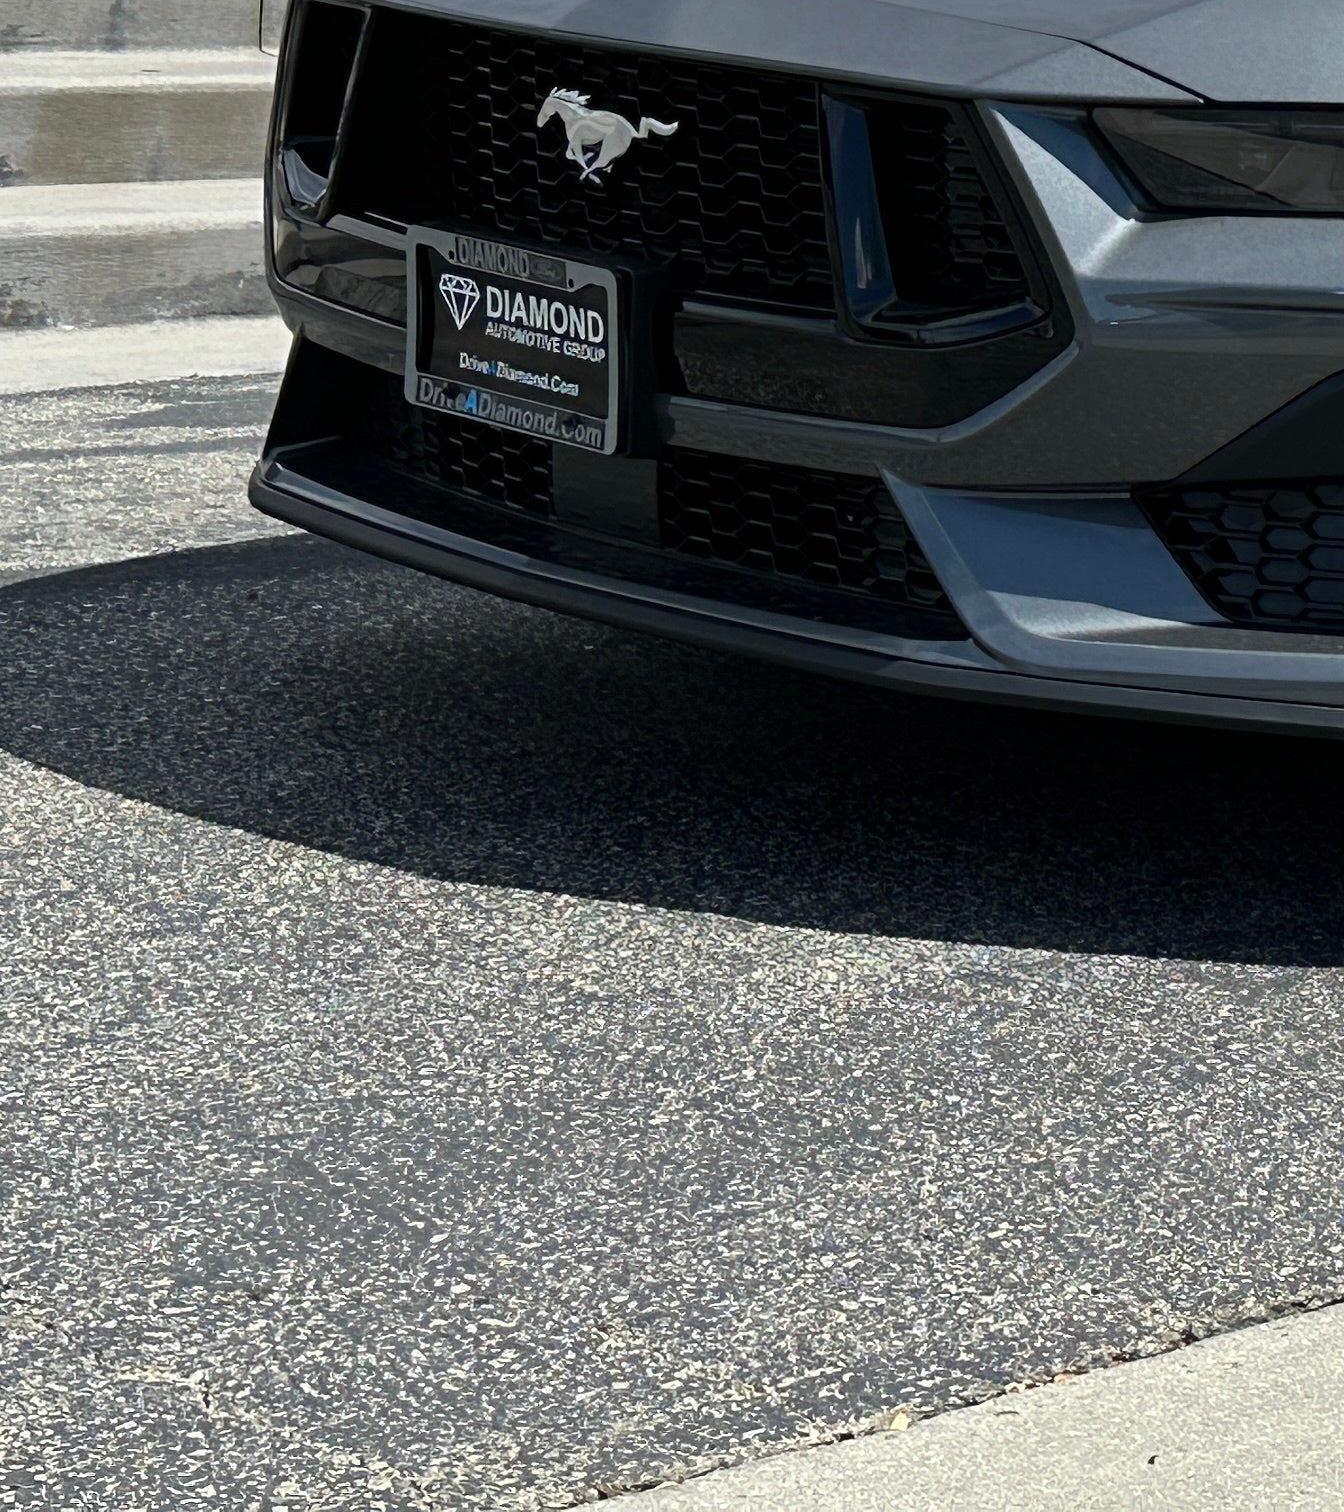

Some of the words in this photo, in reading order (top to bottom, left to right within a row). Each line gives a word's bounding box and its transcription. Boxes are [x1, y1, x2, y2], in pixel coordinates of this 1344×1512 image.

[455, 238, 531, 278] DIAMOND
[486, 285, 605, 343] DIAMOND
[485, 321, 561, 353] AUTOMOTIVE
[563, 340, 606, 363] GROUP
